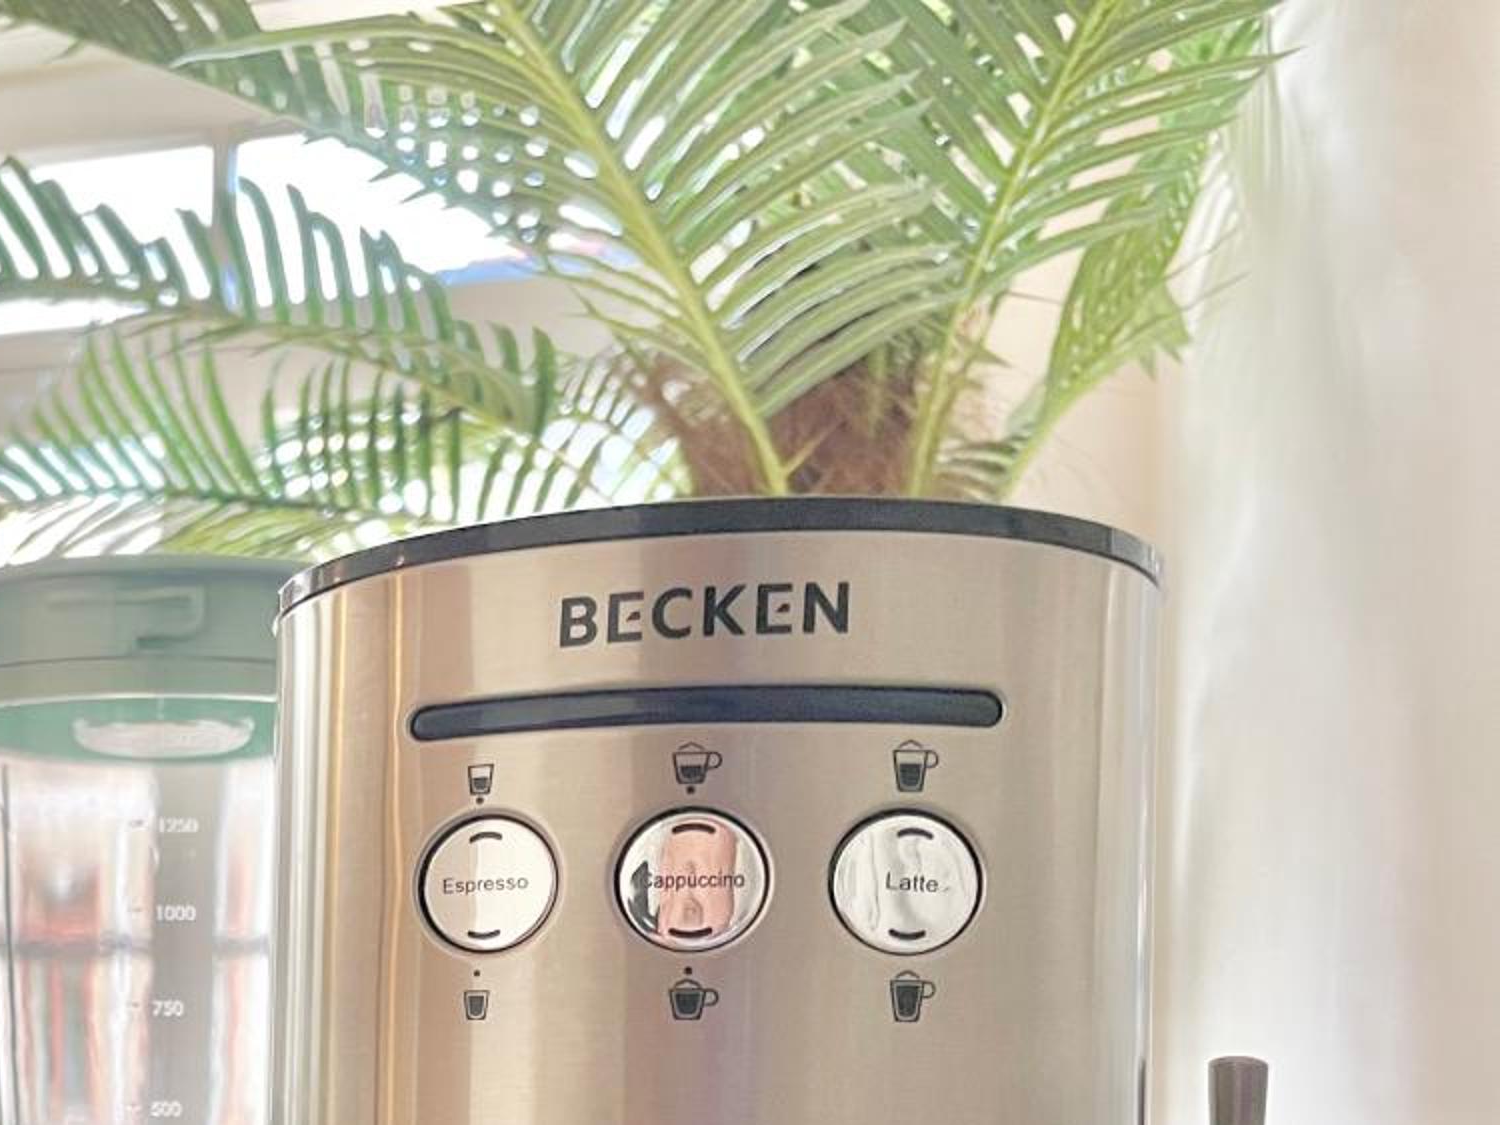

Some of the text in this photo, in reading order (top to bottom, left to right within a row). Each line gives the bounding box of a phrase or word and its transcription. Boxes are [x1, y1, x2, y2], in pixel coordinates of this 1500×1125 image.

[558, 581, 850, 648] BECKEN
[442, 874, 529, 897] Espresso
[641, 868, 746, 892] Cappuccino
[885, 872, 940, 893] Latte
[156, 904, 197, 921] 1000
[151, 1000, 184, 1017] 750
[149, 1100, 183, 1117] 500
